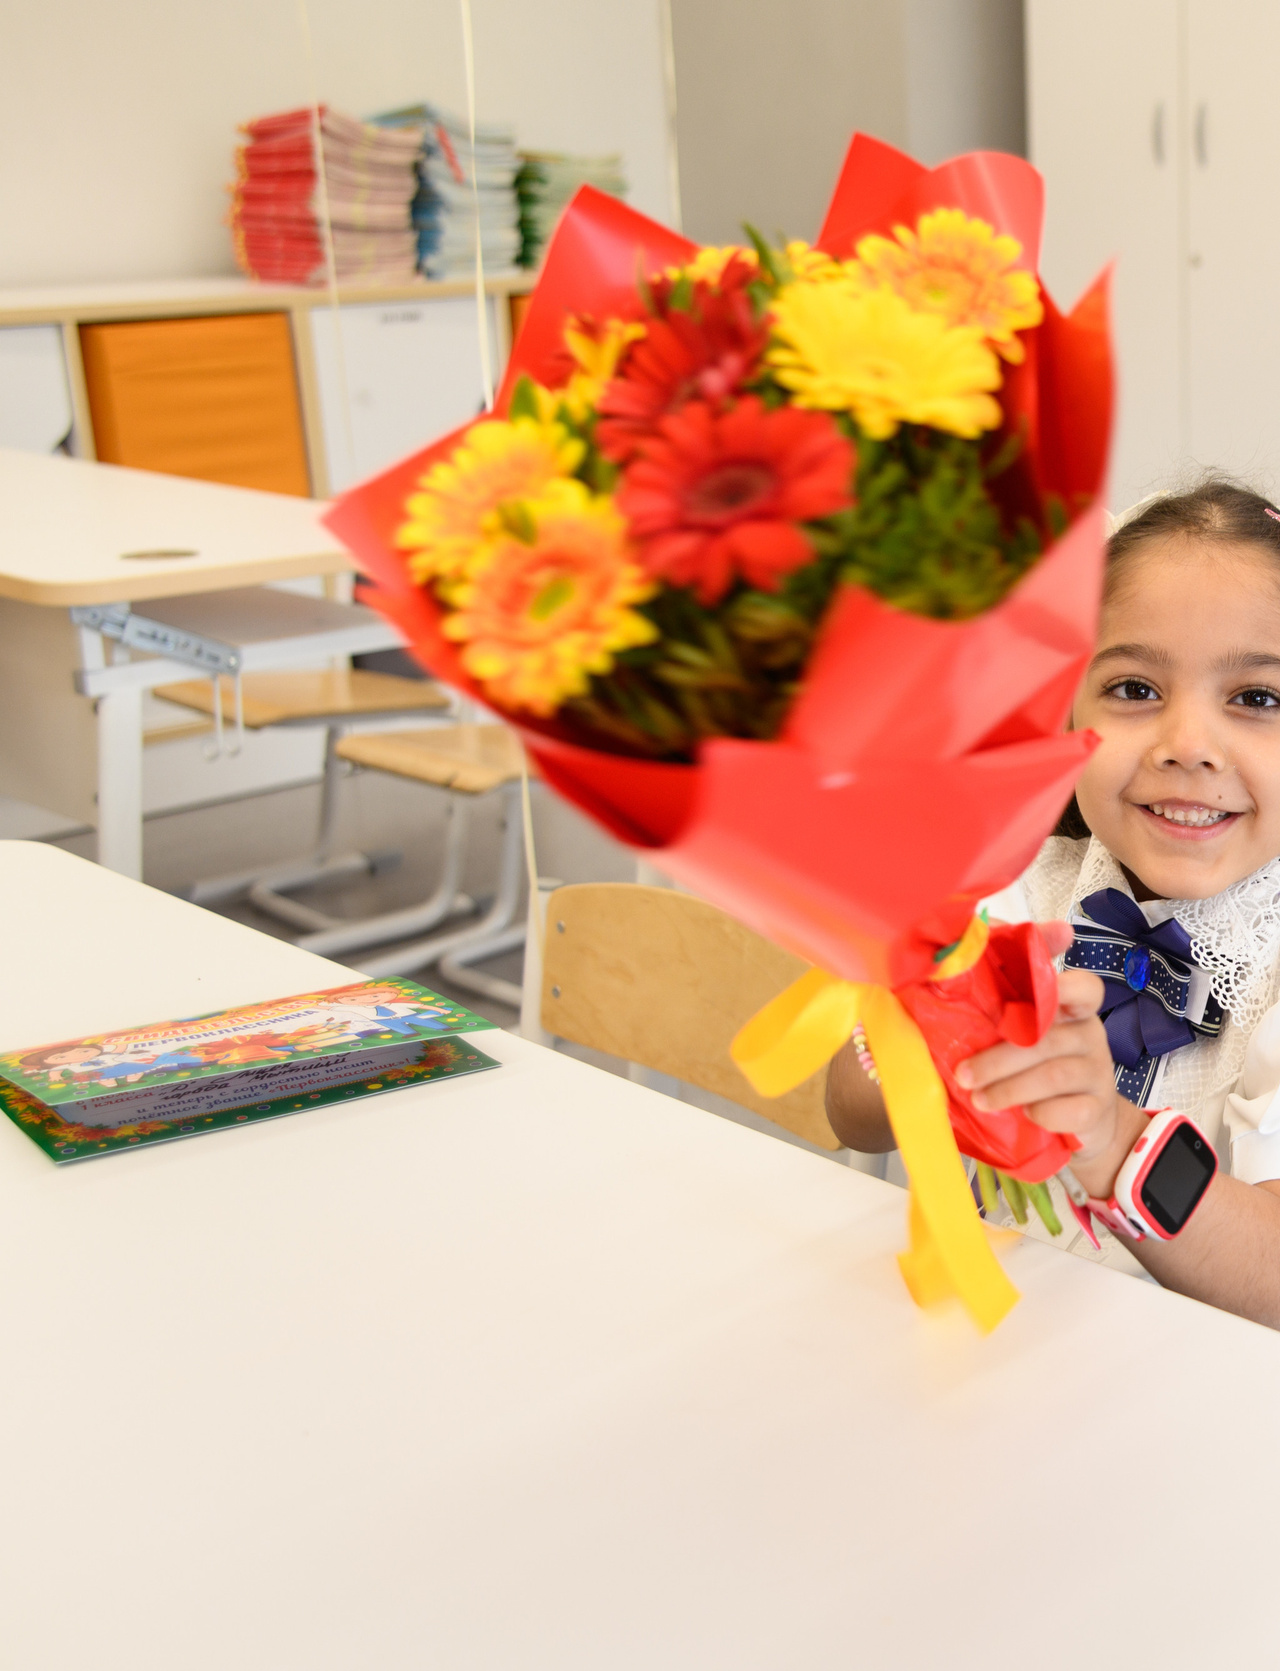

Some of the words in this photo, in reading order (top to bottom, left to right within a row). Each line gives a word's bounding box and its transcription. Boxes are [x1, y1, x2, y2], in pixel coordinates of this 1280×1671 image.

[104, 999, 316, 1044] СВИДЕТЕЛЬСТВО
[133, 1010, 318, 1048] ПЕРВОКЛАССНИКА
[94, 1090, 153, 1108] класса
[118, 1104, 201, 1125] почётное
[206, 1091, 261, 1109] звание
[269, 1058, 410, 1093] «Первоклассник»!
[136, 1107, 146, 1115] и
[153, 1094, 213, 1111] теперь
[233, 1071, 319, 1094] гордостью
[325, 1060, 375, 1074] носит
